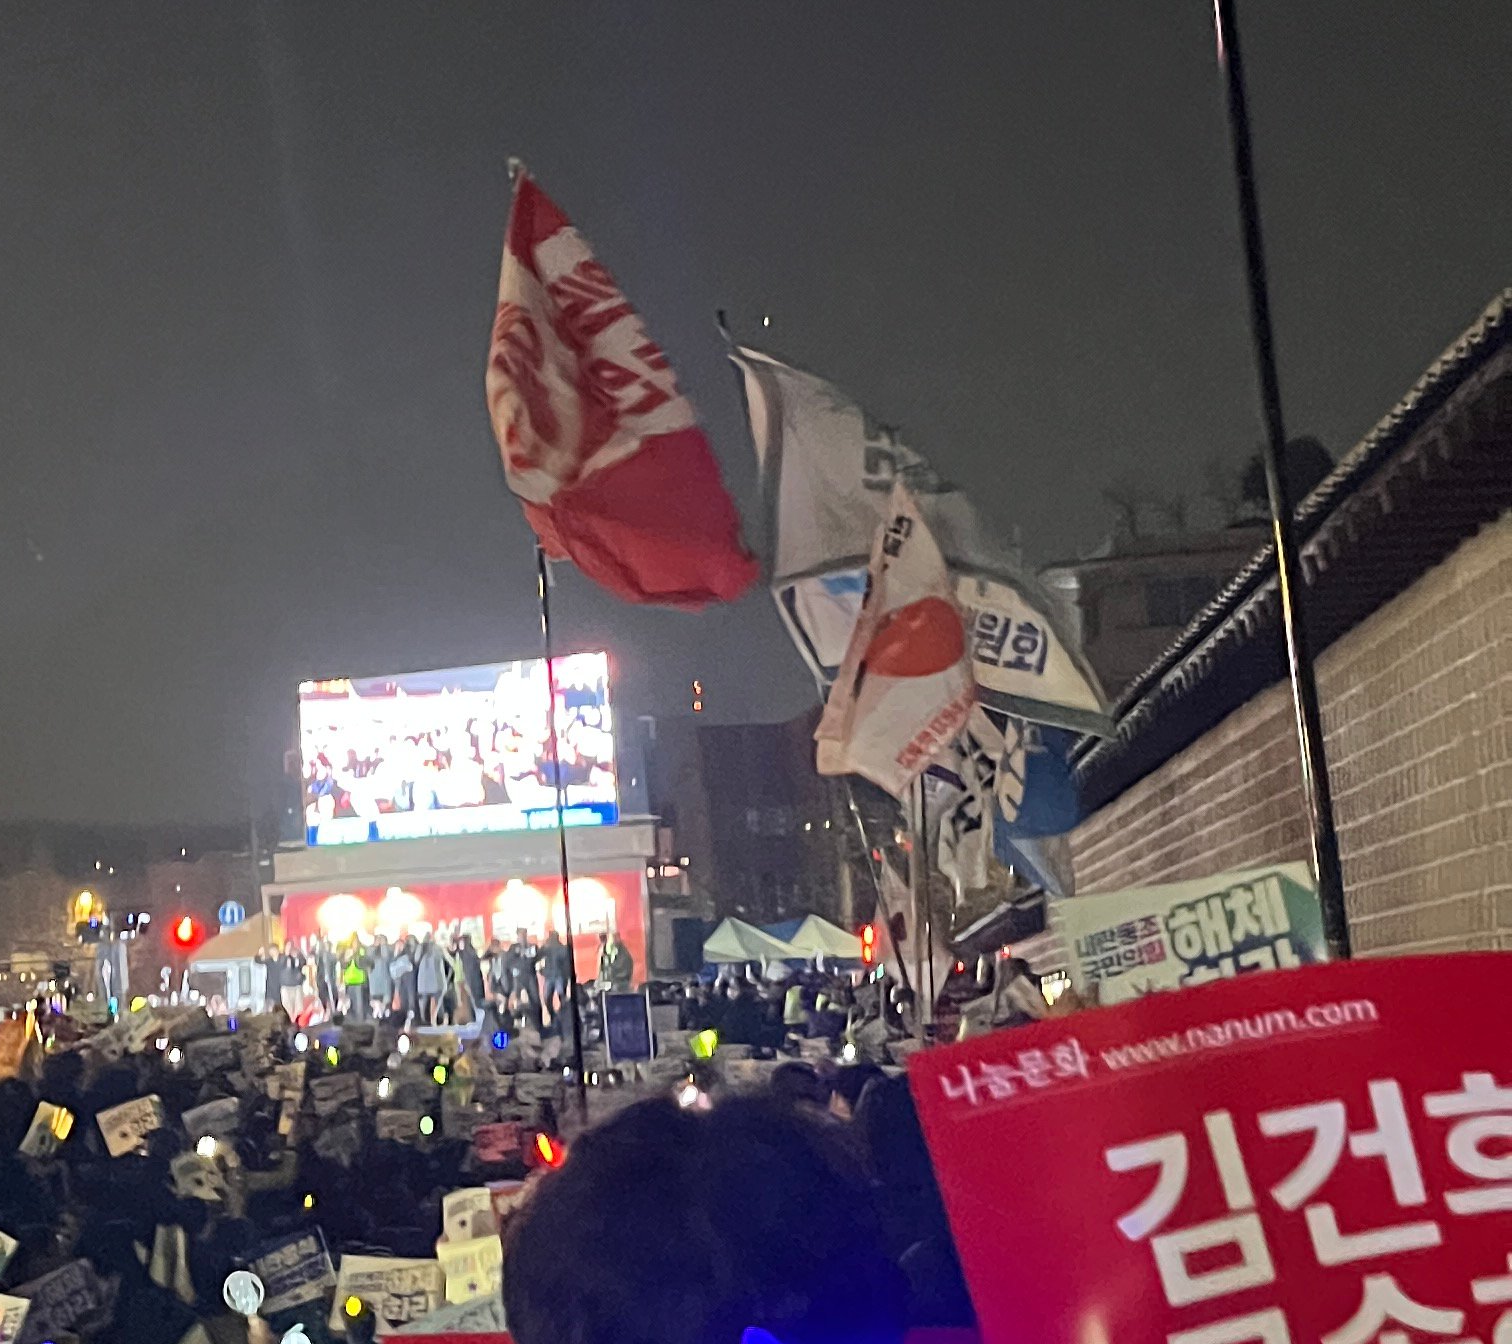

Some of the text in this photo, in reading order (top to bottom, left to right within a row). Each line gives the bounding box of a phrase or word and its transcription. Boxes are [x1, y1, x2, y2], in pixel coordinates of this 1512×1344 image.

[1075, 914, 1162, 958] 내란동조
[1166, 872, 1291, 962] 해체
[1100, 997, 1379, 1070] www.nanum.com
